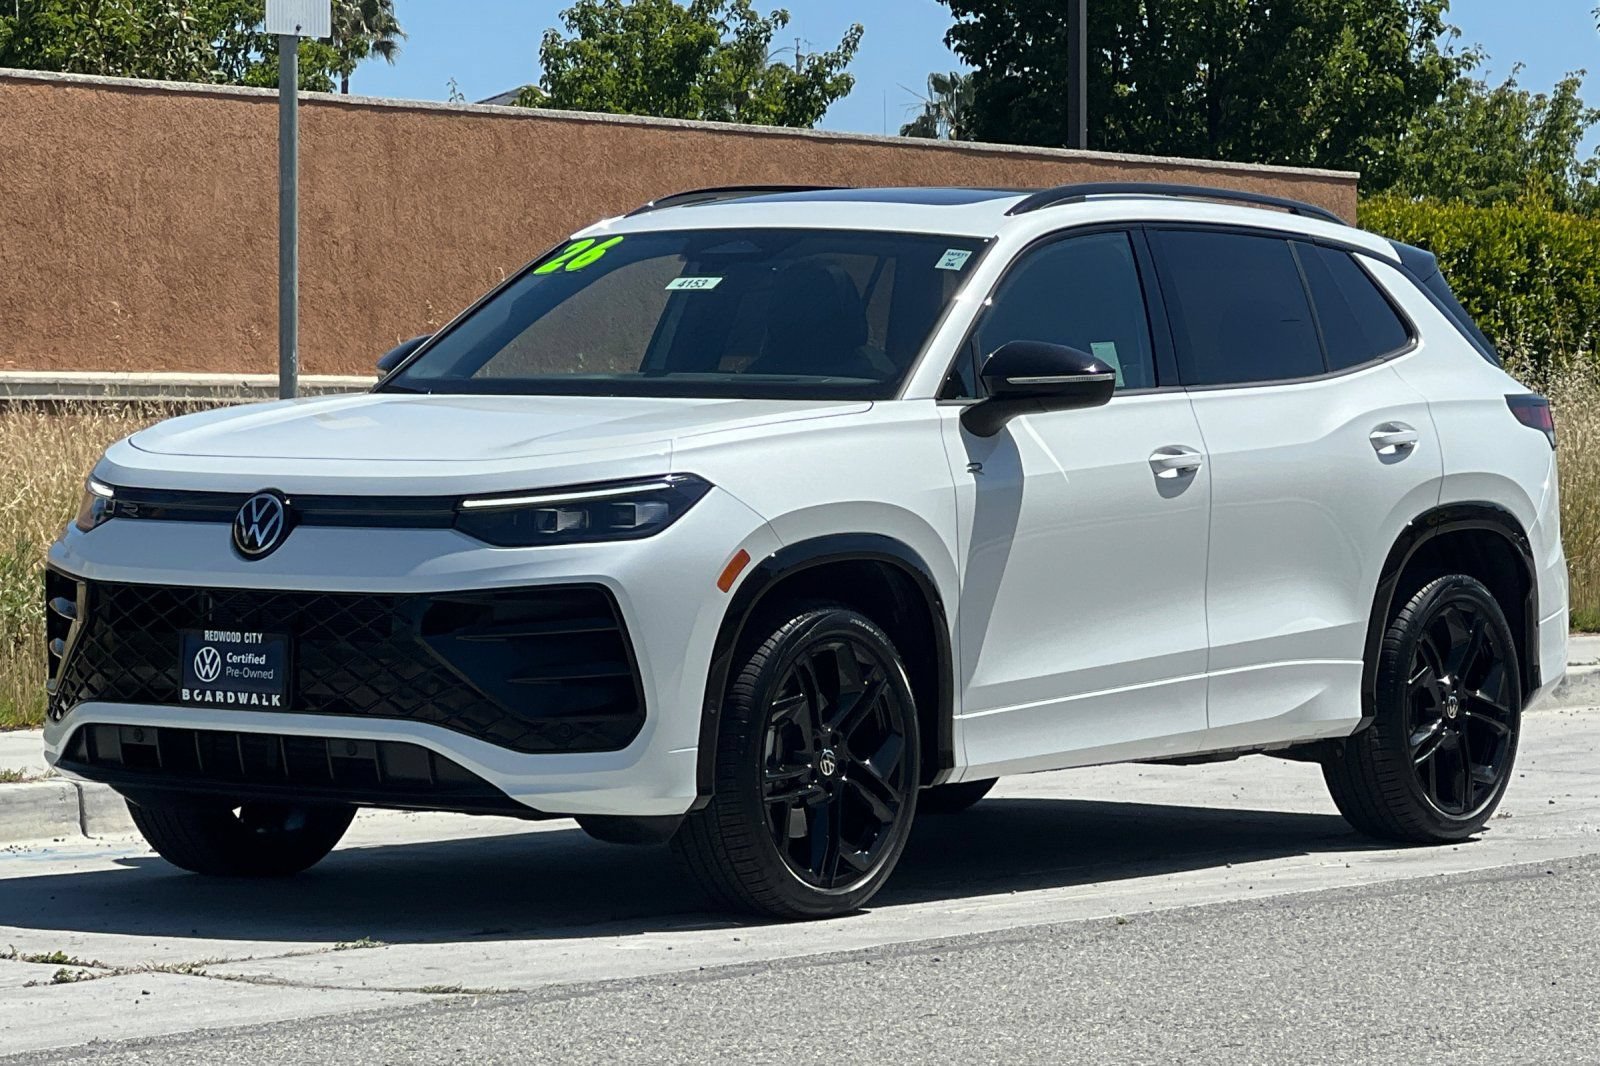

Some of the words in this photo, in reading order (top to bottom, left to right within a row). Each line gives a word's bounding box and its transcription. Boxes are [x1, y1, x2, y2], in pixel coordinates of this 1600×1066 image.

[533, 236, 624, 275] 26
[677, 279, 708, 288] 4153
[204, 630, 242, 643] REDWOOD
[244, 632, 263, 644] CITY
[226, 652, 266, 665] Certified
[225, 666, 274, 679] Pre-Owned
[182, 688, 281, 707] BOARDWALK
